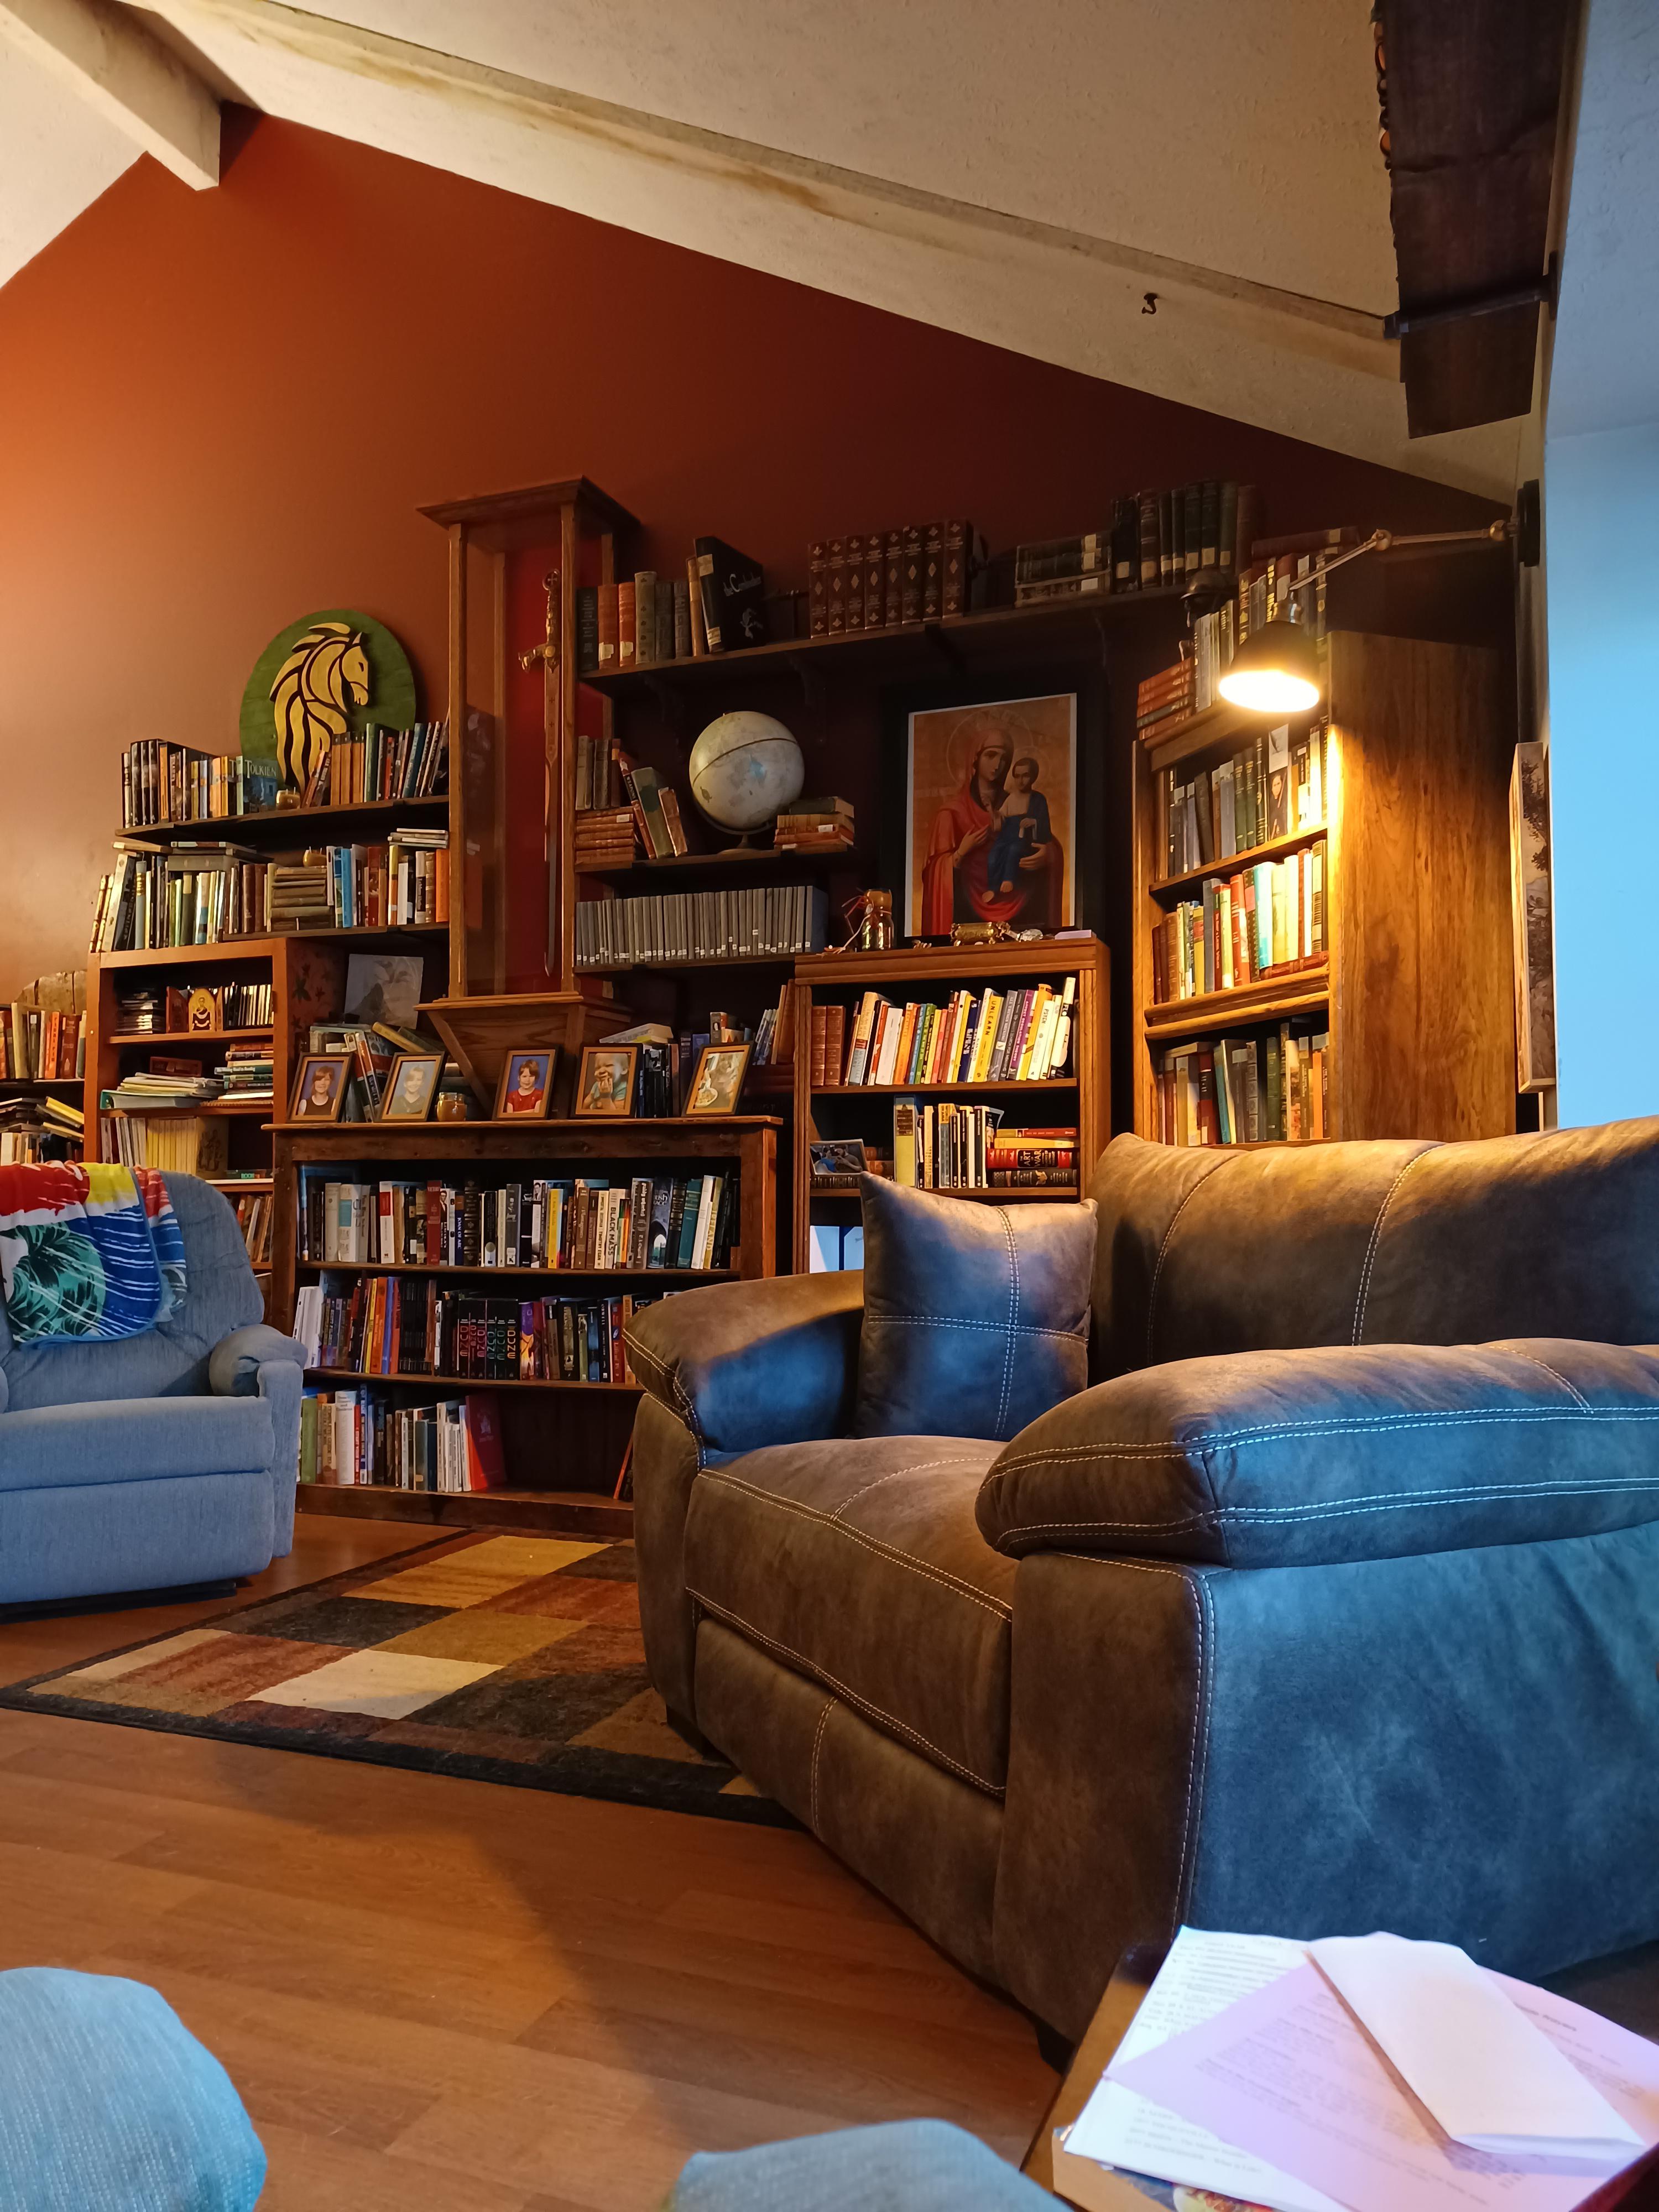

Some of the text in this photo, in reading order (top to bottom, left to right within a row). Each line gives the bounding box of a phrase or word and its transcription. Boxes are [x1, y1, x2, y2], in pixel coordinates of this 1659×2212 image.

[244, 759, 276, 779] TOLKIEN
[984, 1000, 996, 1035] UNLEARN
[1034, 1149, 1042, 1167] WAR
[706, 1211, 717, 1251] IRELAND
[477, 1329, 486, 1358] DUNE
[507, 1330, 516, 1359] DUNE
